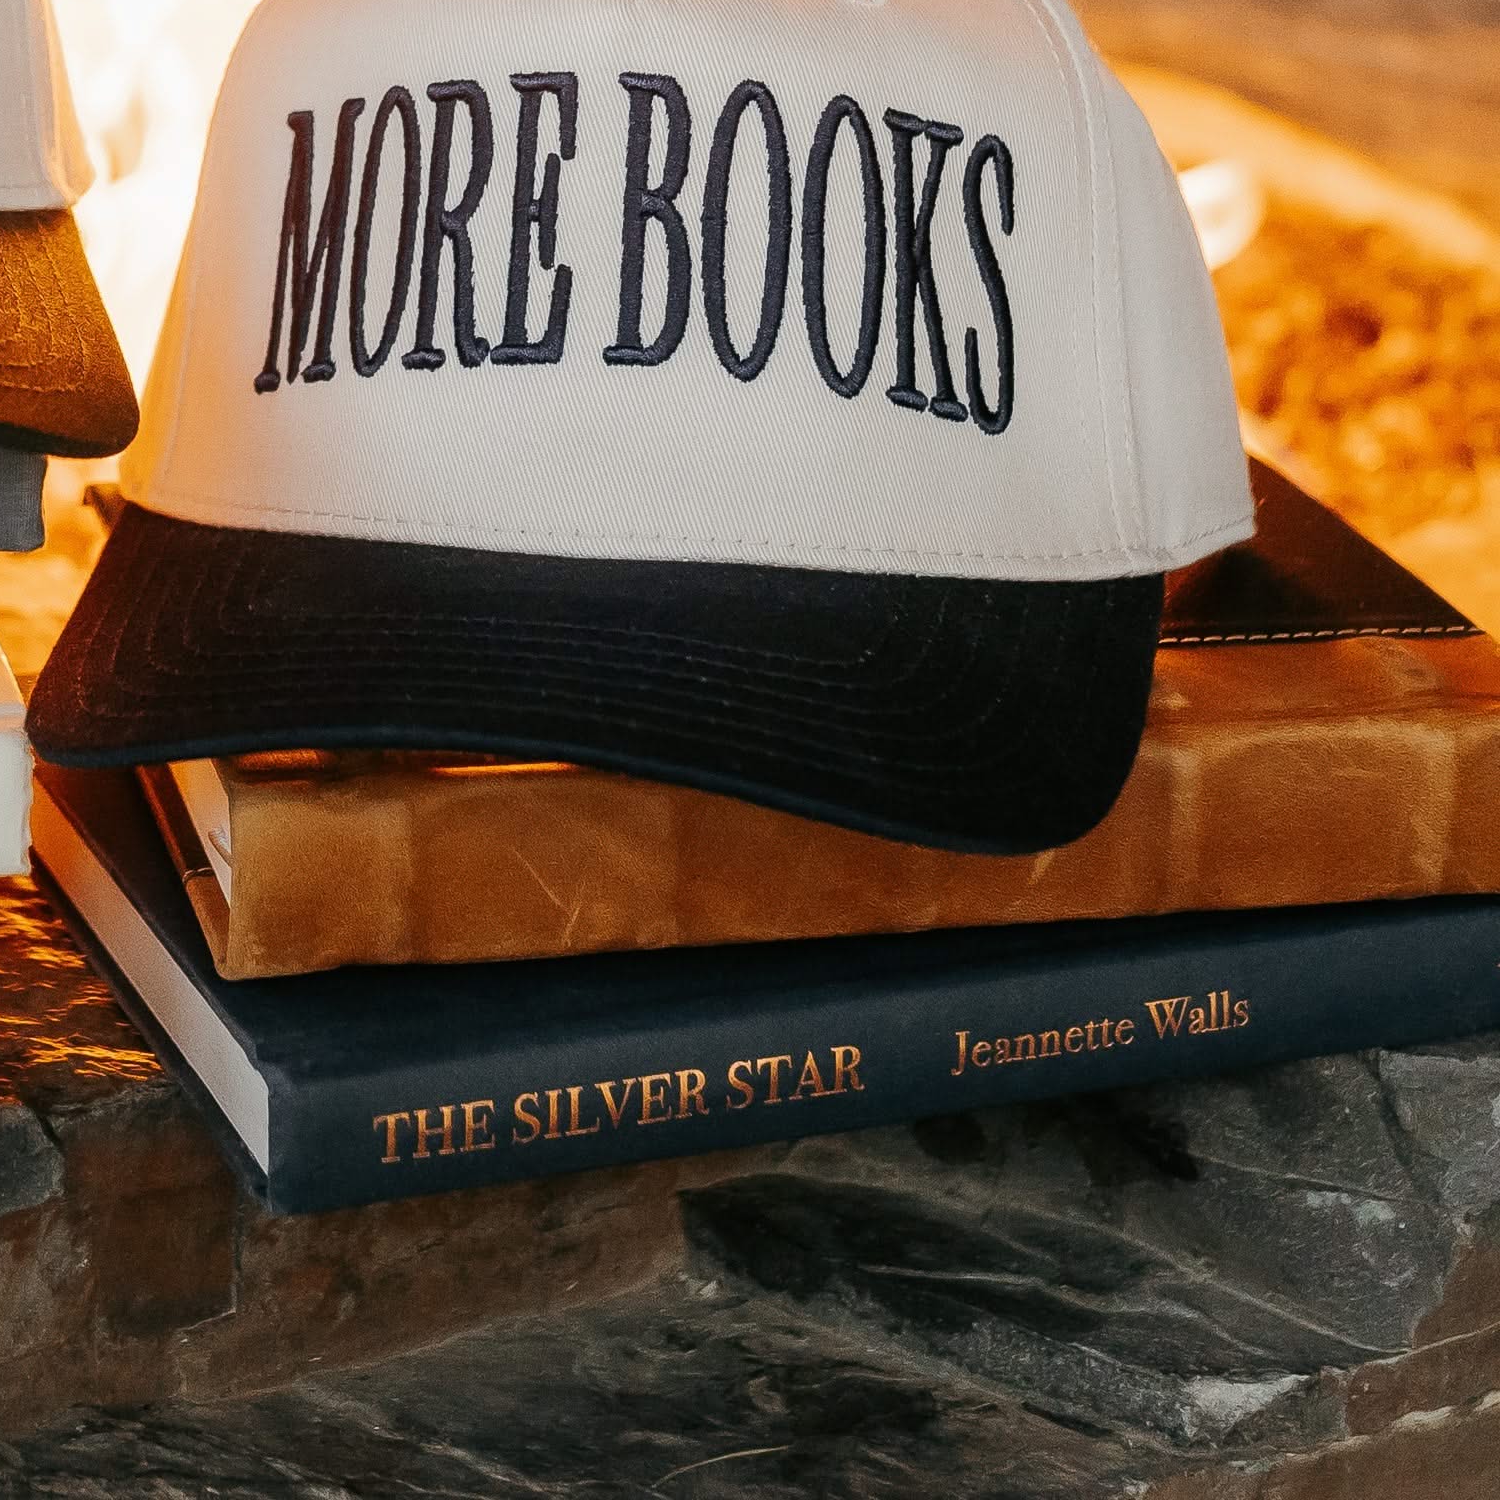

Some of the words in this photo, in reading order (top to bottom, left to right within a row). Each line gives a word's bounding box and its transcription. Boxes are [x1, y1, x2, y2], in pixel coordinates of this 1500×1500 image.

[254, 71, 578, 394] MORE
[604, 71, 1015, 436] BOOKS
[950, 1017, 1135, 1077] Jeannette
[1144, 990, 1250, 1040] Walls
[373, 1100, 497, 1165] THE
[512, 1068, 711, 1146] SILVER
[726, 1045, 866, 1110] STAR
